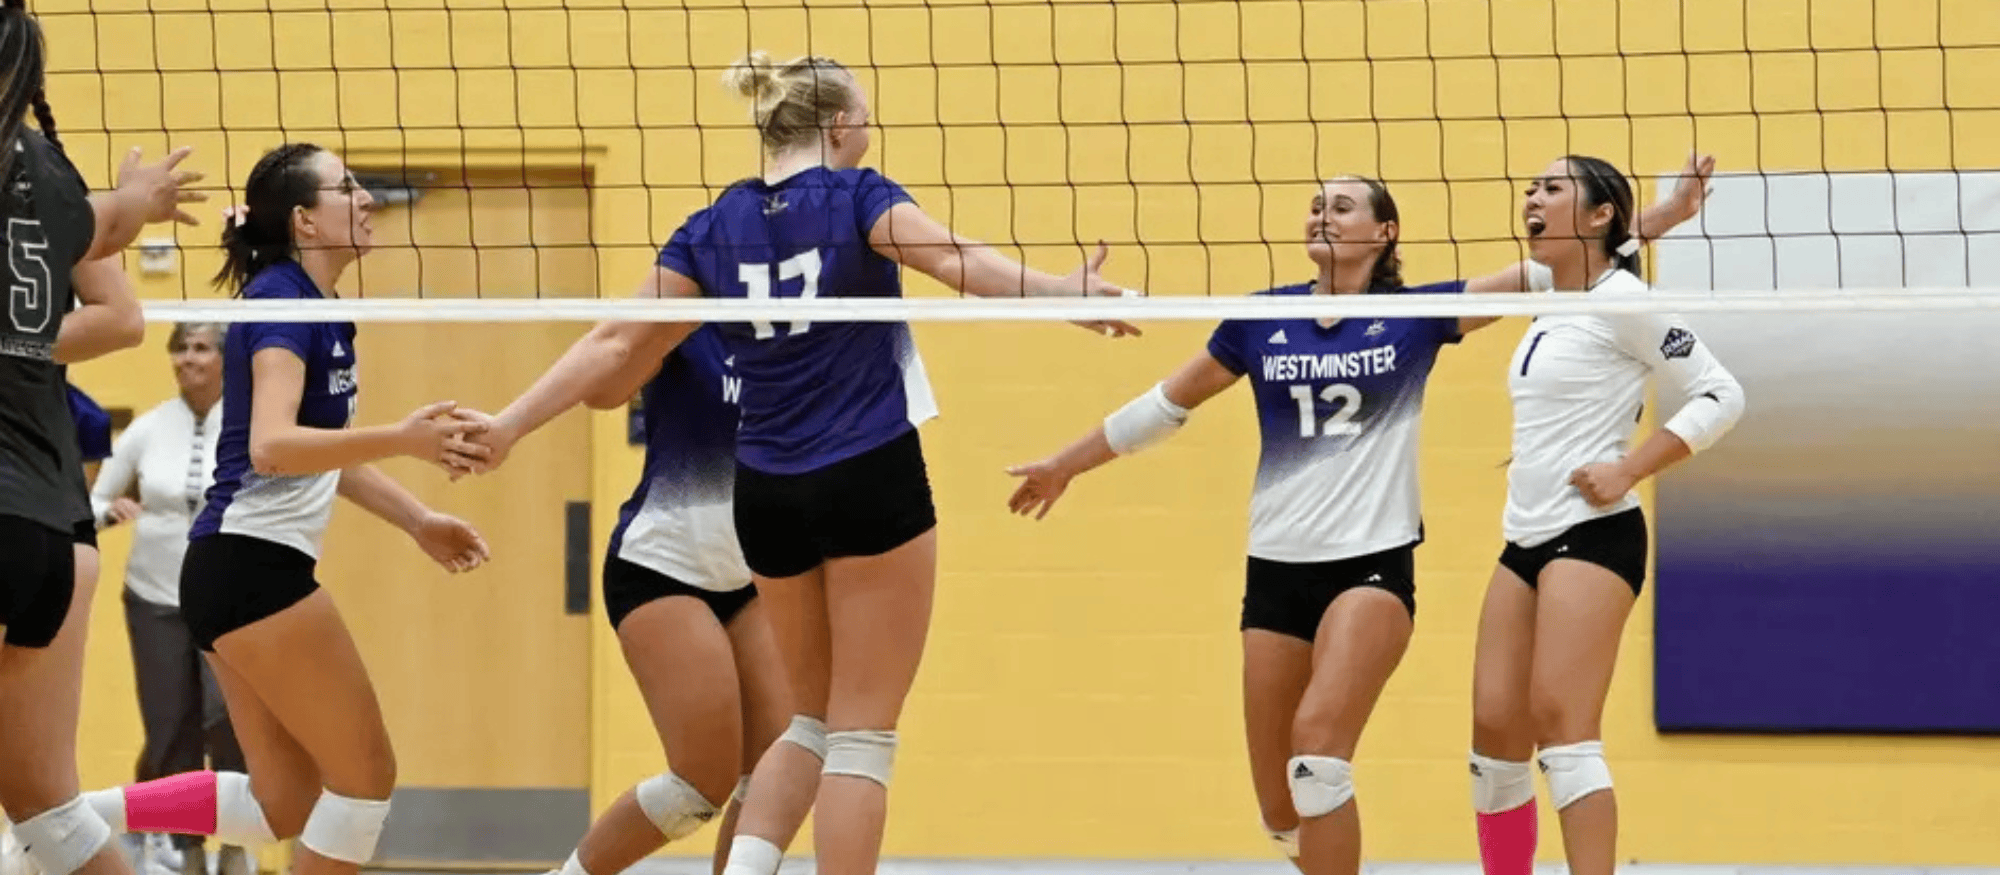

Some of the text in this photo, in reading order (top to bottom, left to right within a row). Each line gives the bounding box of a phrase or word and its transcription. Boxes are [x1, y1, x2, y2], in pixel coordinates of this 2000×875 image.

[7, 217, 51, 333] 5
[738, 247, 822, 340] 17
[1262, 344, 1396, 381] WESTMINSTER
[1289, 383, 1362, 438] 12
